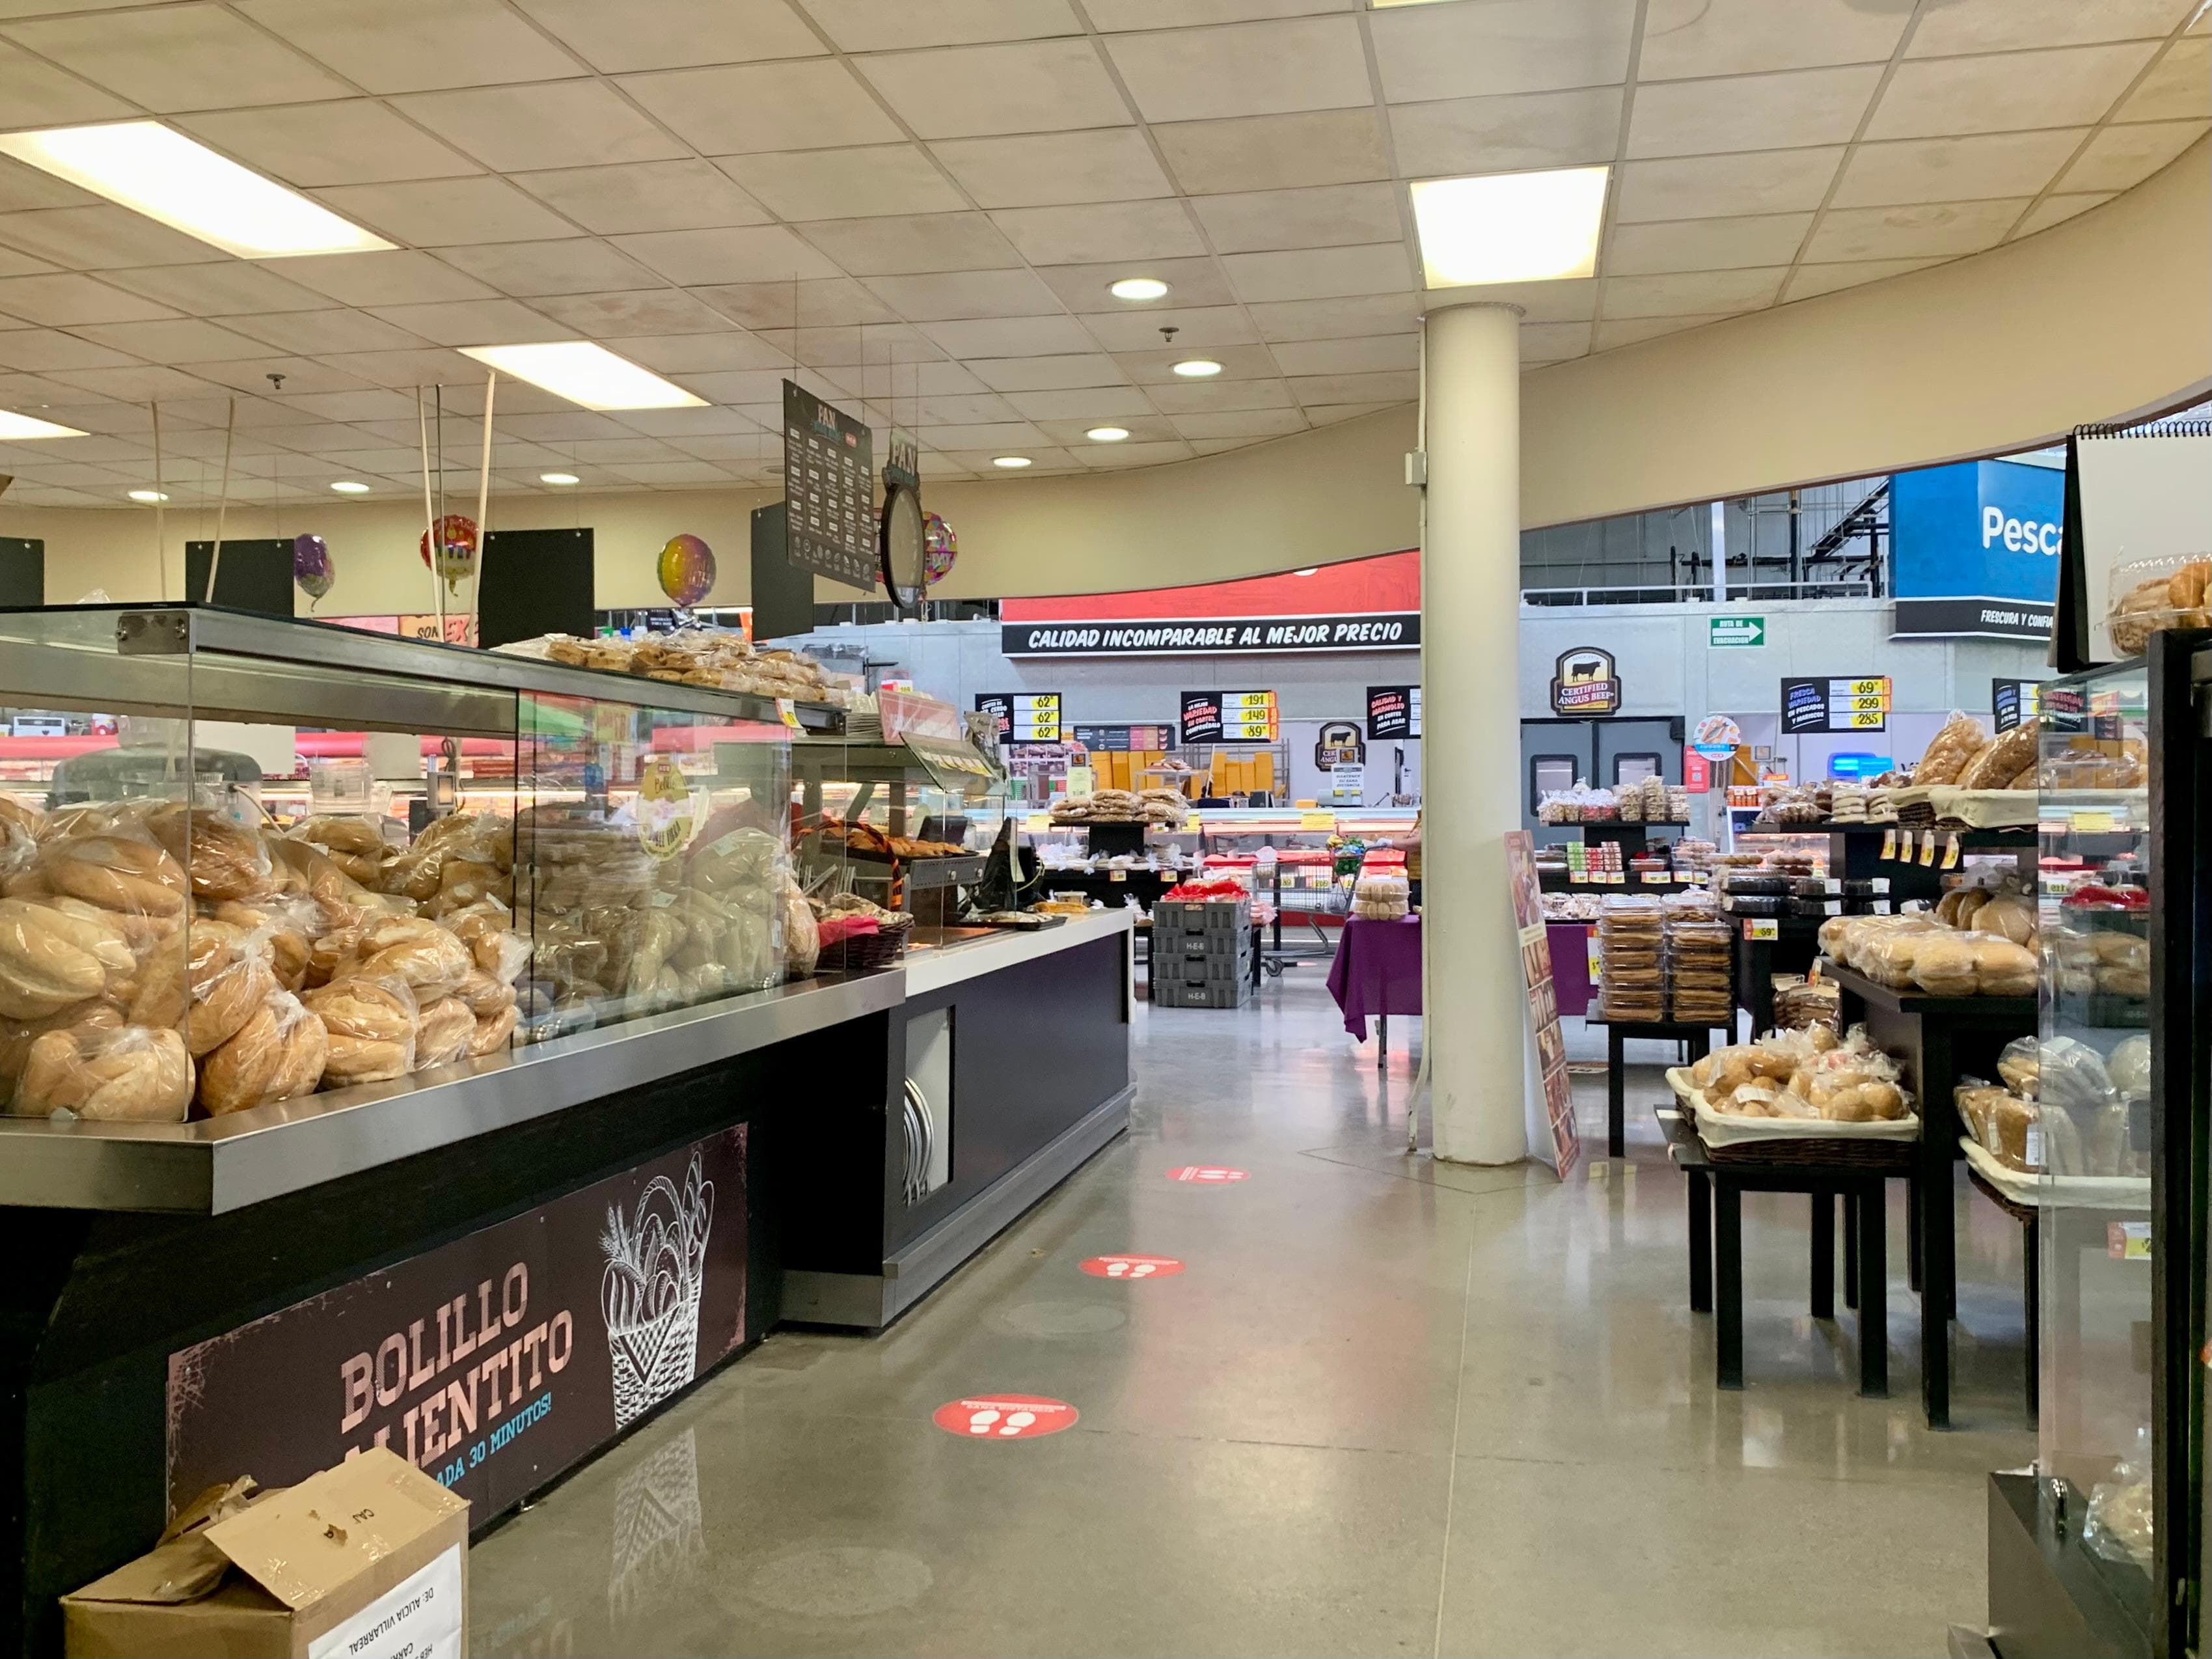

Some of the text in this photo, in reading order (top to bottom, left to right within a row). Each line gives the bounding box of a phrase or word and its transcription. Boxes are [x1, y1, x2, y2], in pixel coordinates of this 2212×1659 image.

[818, 404, 836, 430] PAN
[1981, 610, 2053, 629] FRESCURA Y CONFIA
[1028, 622, 1402, 648] CALIDAD INCOMPARABLE AL MEJOR PRECIO
[1561, 682, 1608, 696] CERTIFIED
[1790, 687, 1816, 700] FRESCA
[1371, 695, 1396, 709] CALIDAD
[1558, 694, 1591, 704] ANGUS
[1788, 695, 1822, 709] VARIEDAD
[1183, 706, 1218, 721] VARIEDAD
[1796, 704, 1825, 715] PESCADOS
[1377, 720, 1391, 730] PARA
[340, 1261, 528, 1434] BOLILLO
[345, 1309, 573, 1471] IENTITO
[437, 1392, 552, 1488] ADA 30 MINUTOS!
[349, 1587, 434, 1655] DE: ALICIA VILLARREAL
